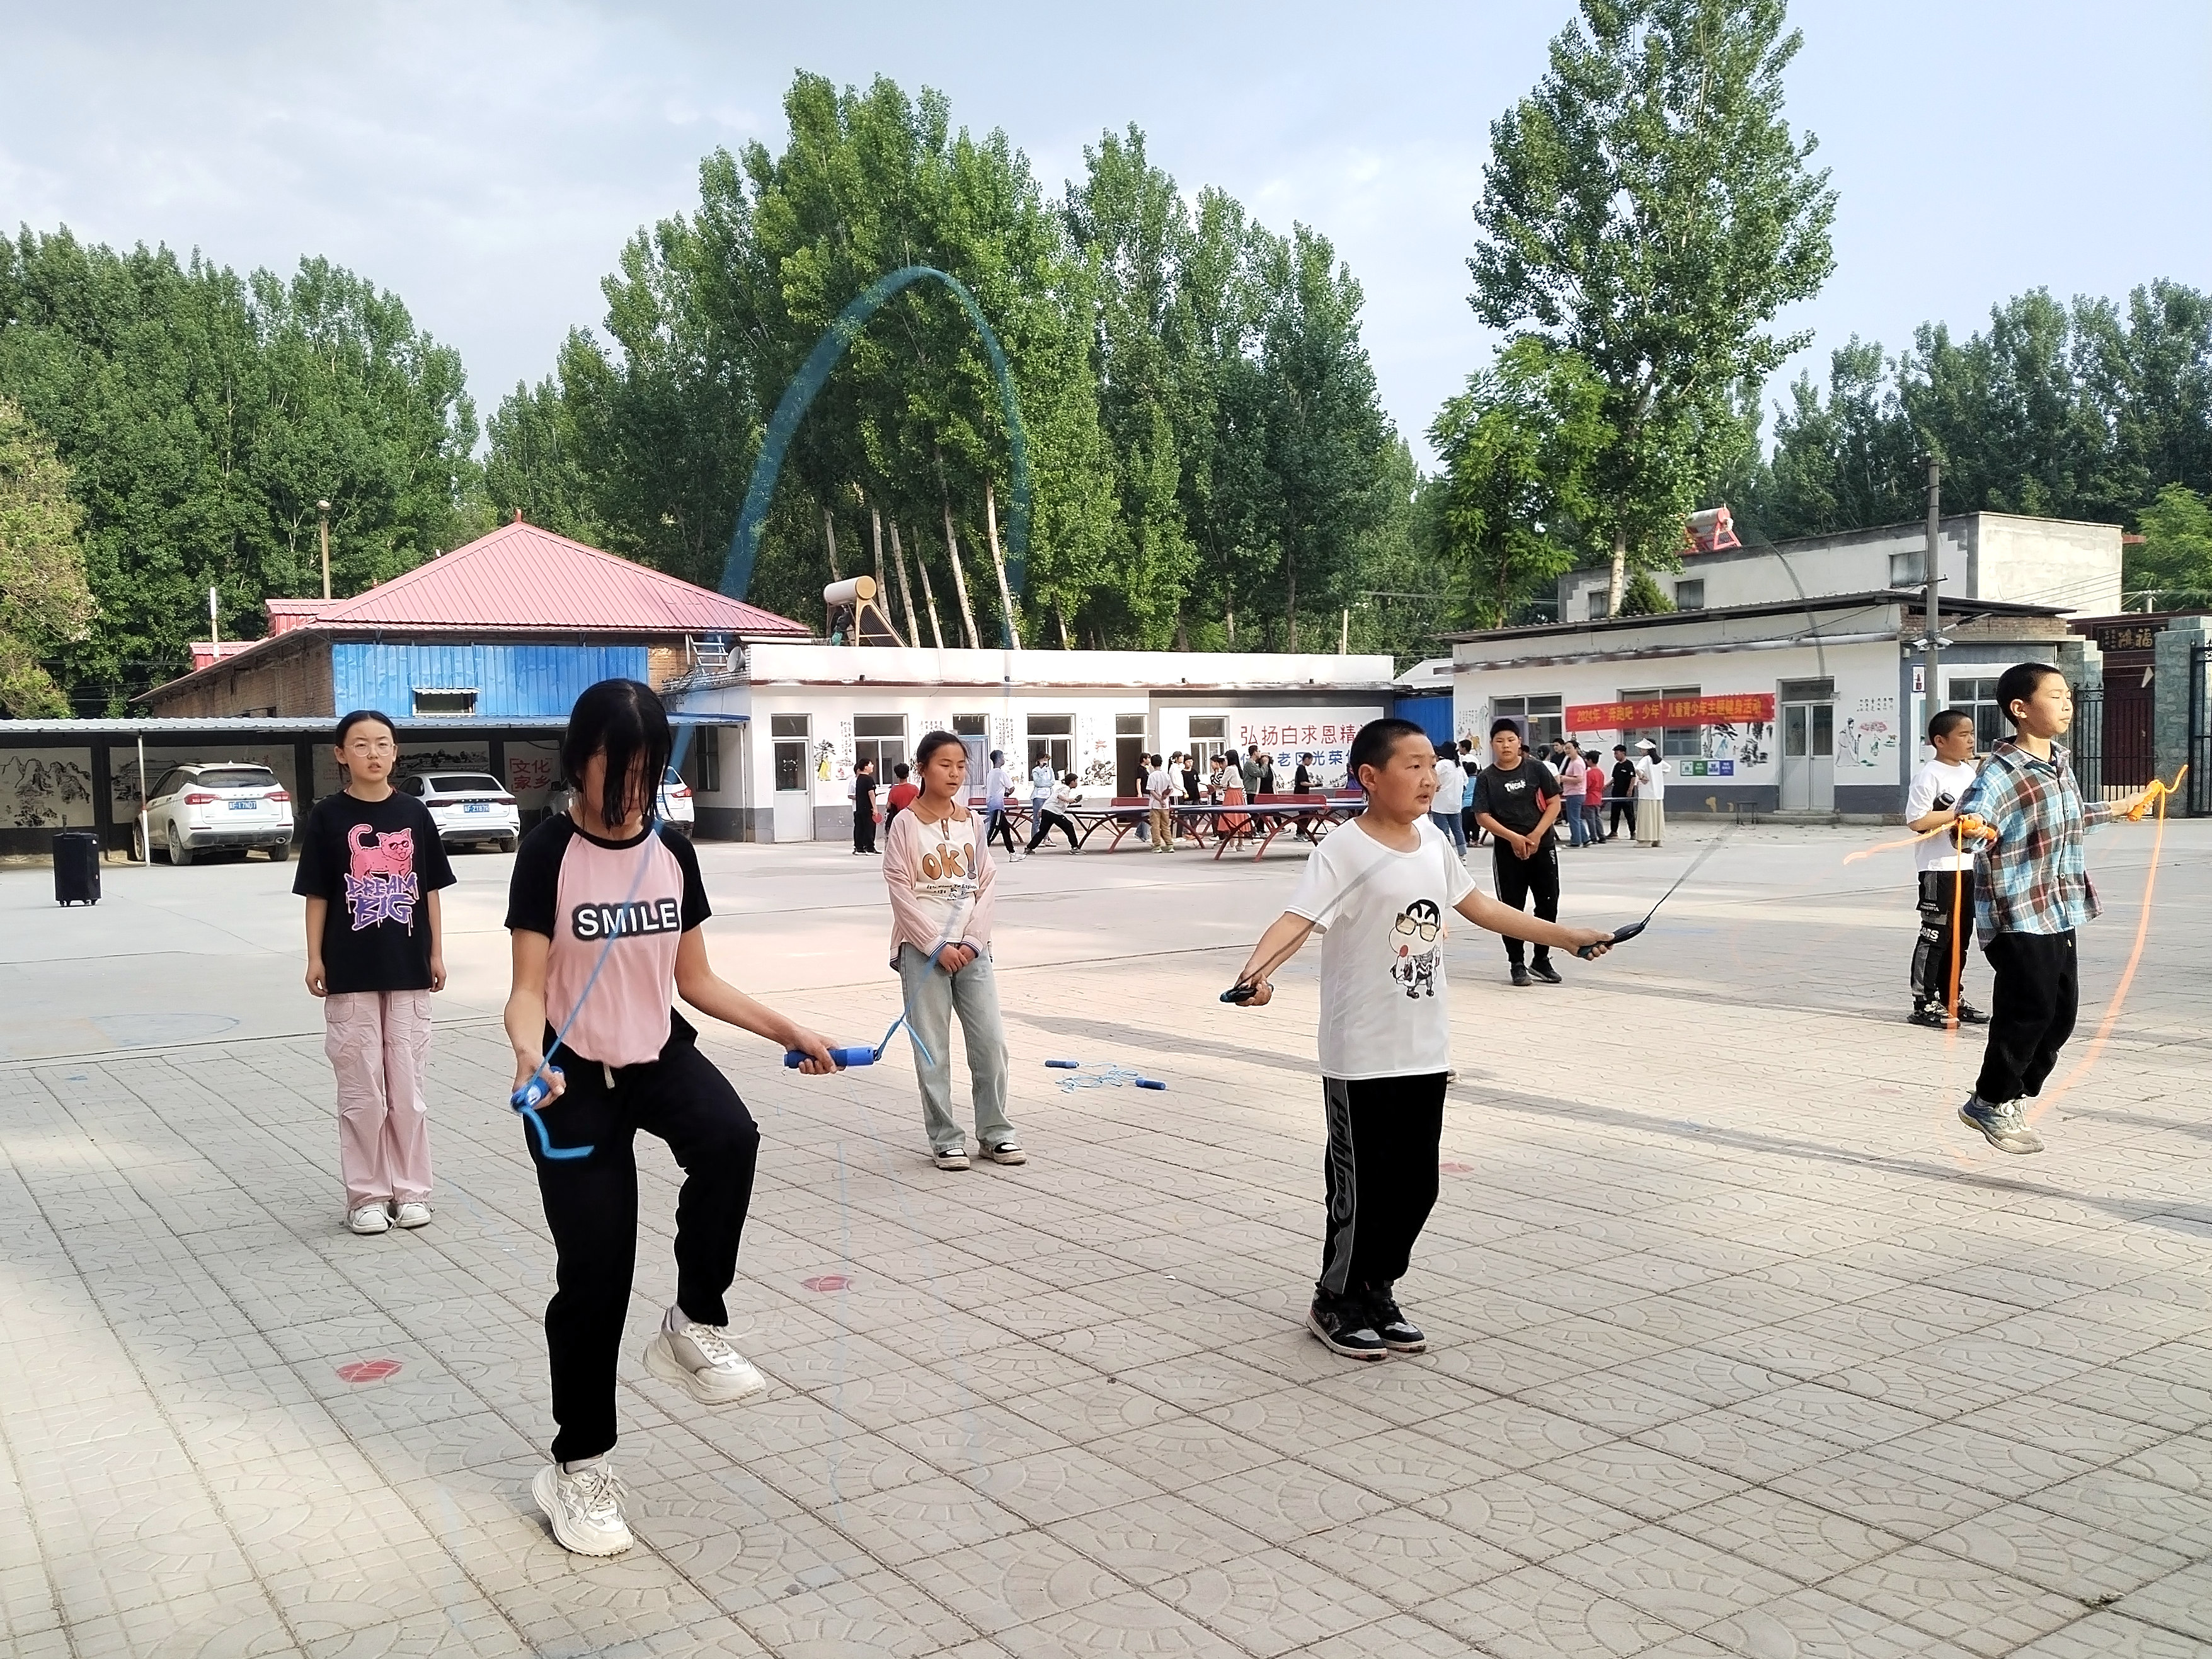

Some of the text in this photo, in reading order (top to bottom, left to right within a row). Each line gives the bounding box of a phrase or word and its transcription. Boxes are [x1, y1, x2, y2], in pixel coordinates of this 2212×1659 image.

[1241, 724, 1363, 746] 弘扬白求恩精
[512, 759, 551, 774] 文化
[513, 775, 551, 790] 家乡
[344, 872, 418, 900] DREAM
[350, 893, 416, 931] BIG
[578, 903, 678, 936] SMILE
